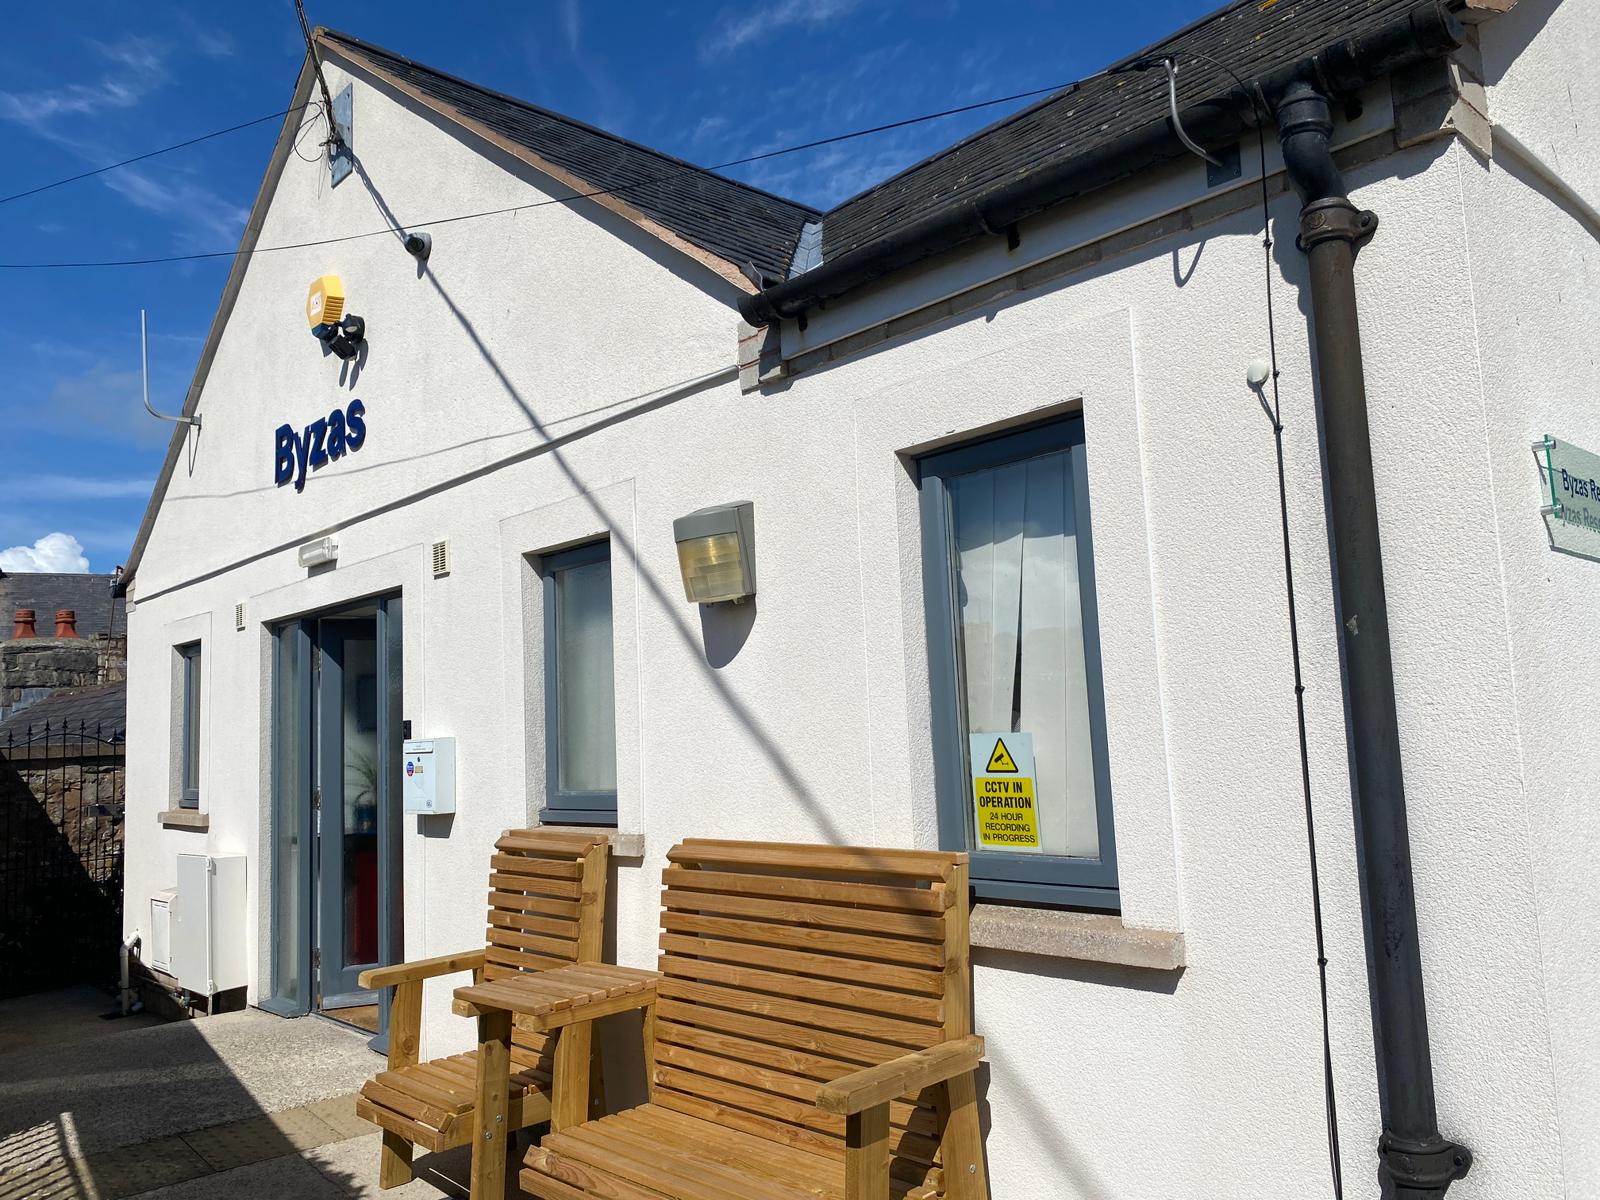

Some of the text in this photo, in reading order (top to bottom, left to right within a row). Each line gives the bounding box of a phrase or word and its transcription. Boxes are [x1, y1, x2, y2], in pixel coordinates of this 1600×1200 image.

[275, 399, 366, 492] Byzas
[1561, 468, 1589, 498] Byzas
[985, 781, 1023, 793] CCTV IN
[979, 796, 1032, 809] OPERATION
[989, 812, 1023, 821] 24 HOUR
[985, 822, 1031, 832] RECORDING
[983, 833, 1036, 843] IN PROGRESS
